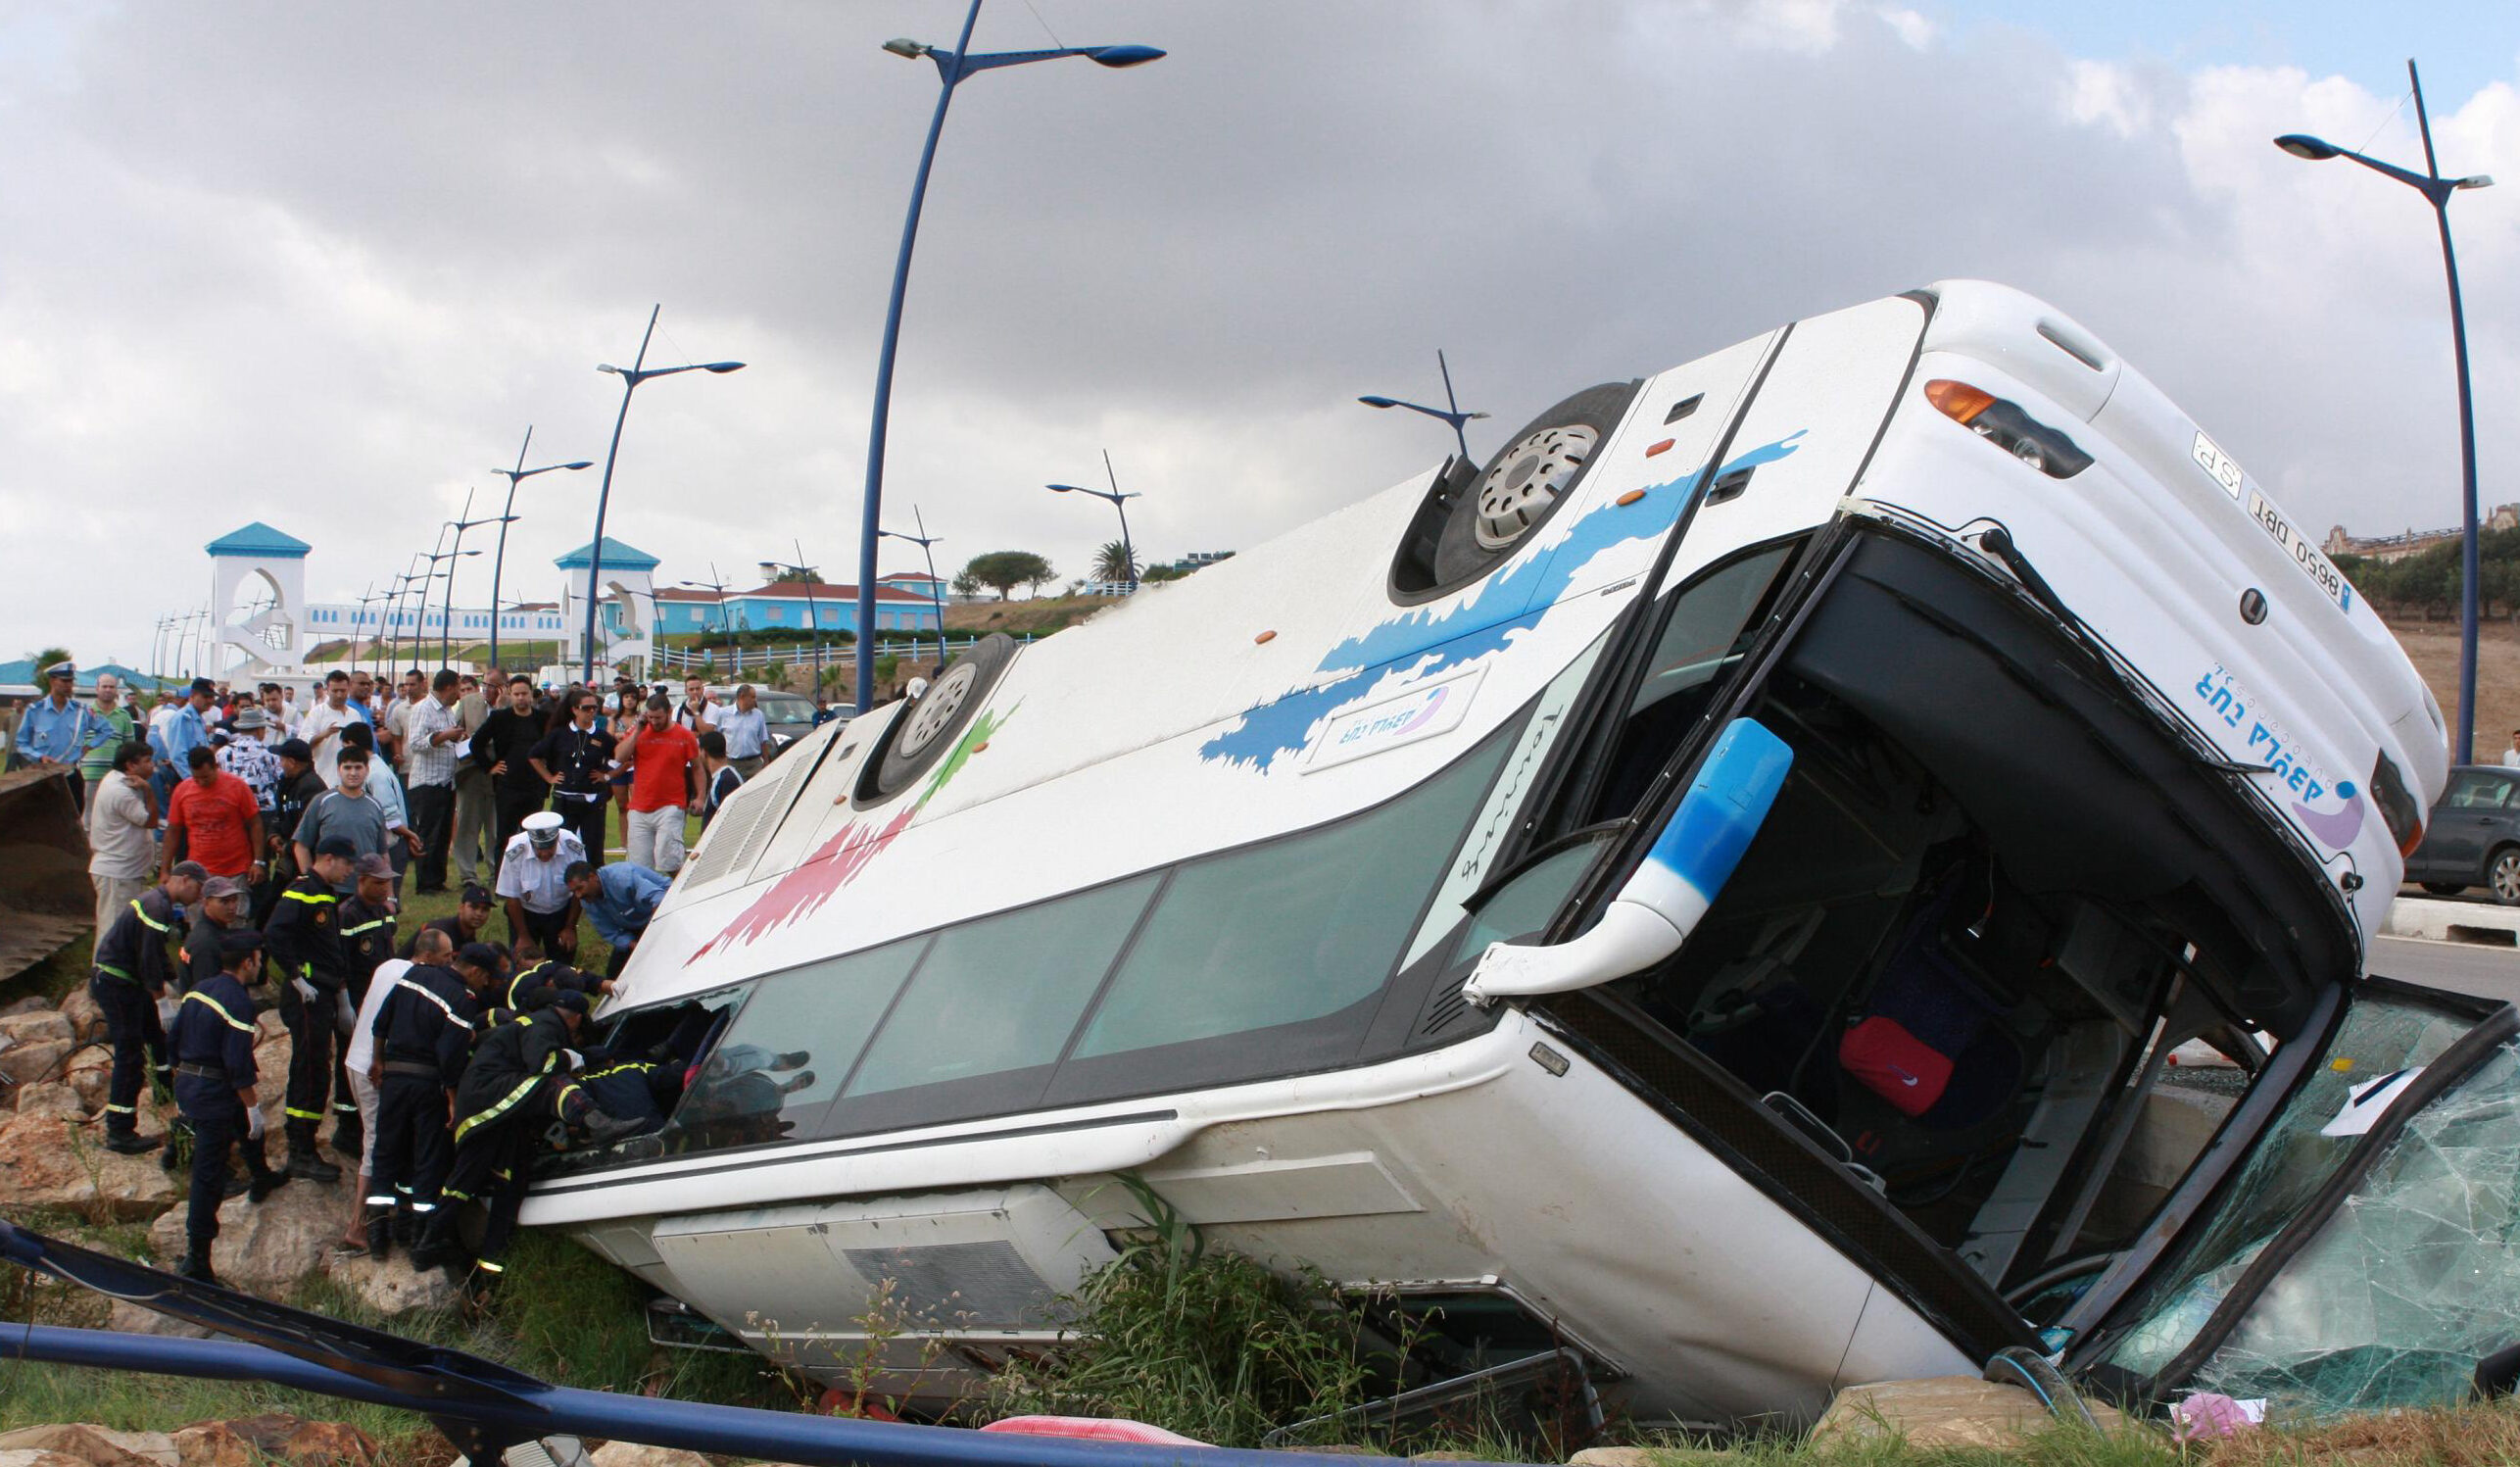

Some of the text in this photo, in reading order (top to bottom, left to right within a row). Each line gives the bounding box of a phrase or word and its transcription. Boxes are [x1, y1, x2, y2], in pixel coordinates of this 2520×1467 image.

[2253, 500, 2339, 597] 8650 DBT
[1461, 704, 1565, 882] Touring
[2195, 672, 2324, 804] ABYLA TUR
